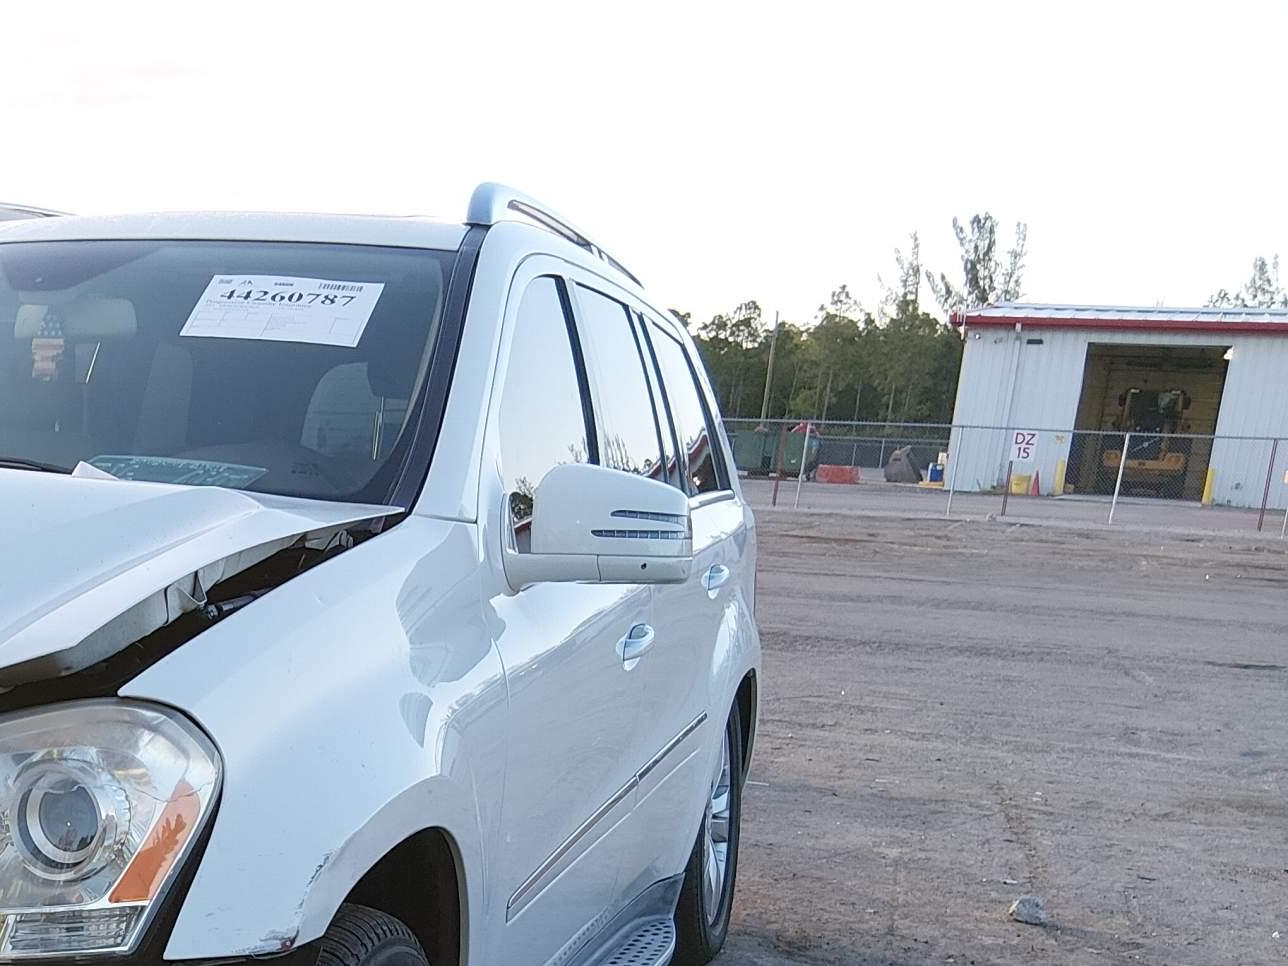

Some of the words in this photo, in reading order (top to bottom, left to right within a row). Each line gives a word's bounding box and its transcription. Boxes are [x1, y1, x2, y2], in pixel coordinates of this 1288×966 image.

[220, 289, 357, 306] 44260787
[1015, 432, 1036, 446] DZ
[1017, 446, 1030, 459] 15
